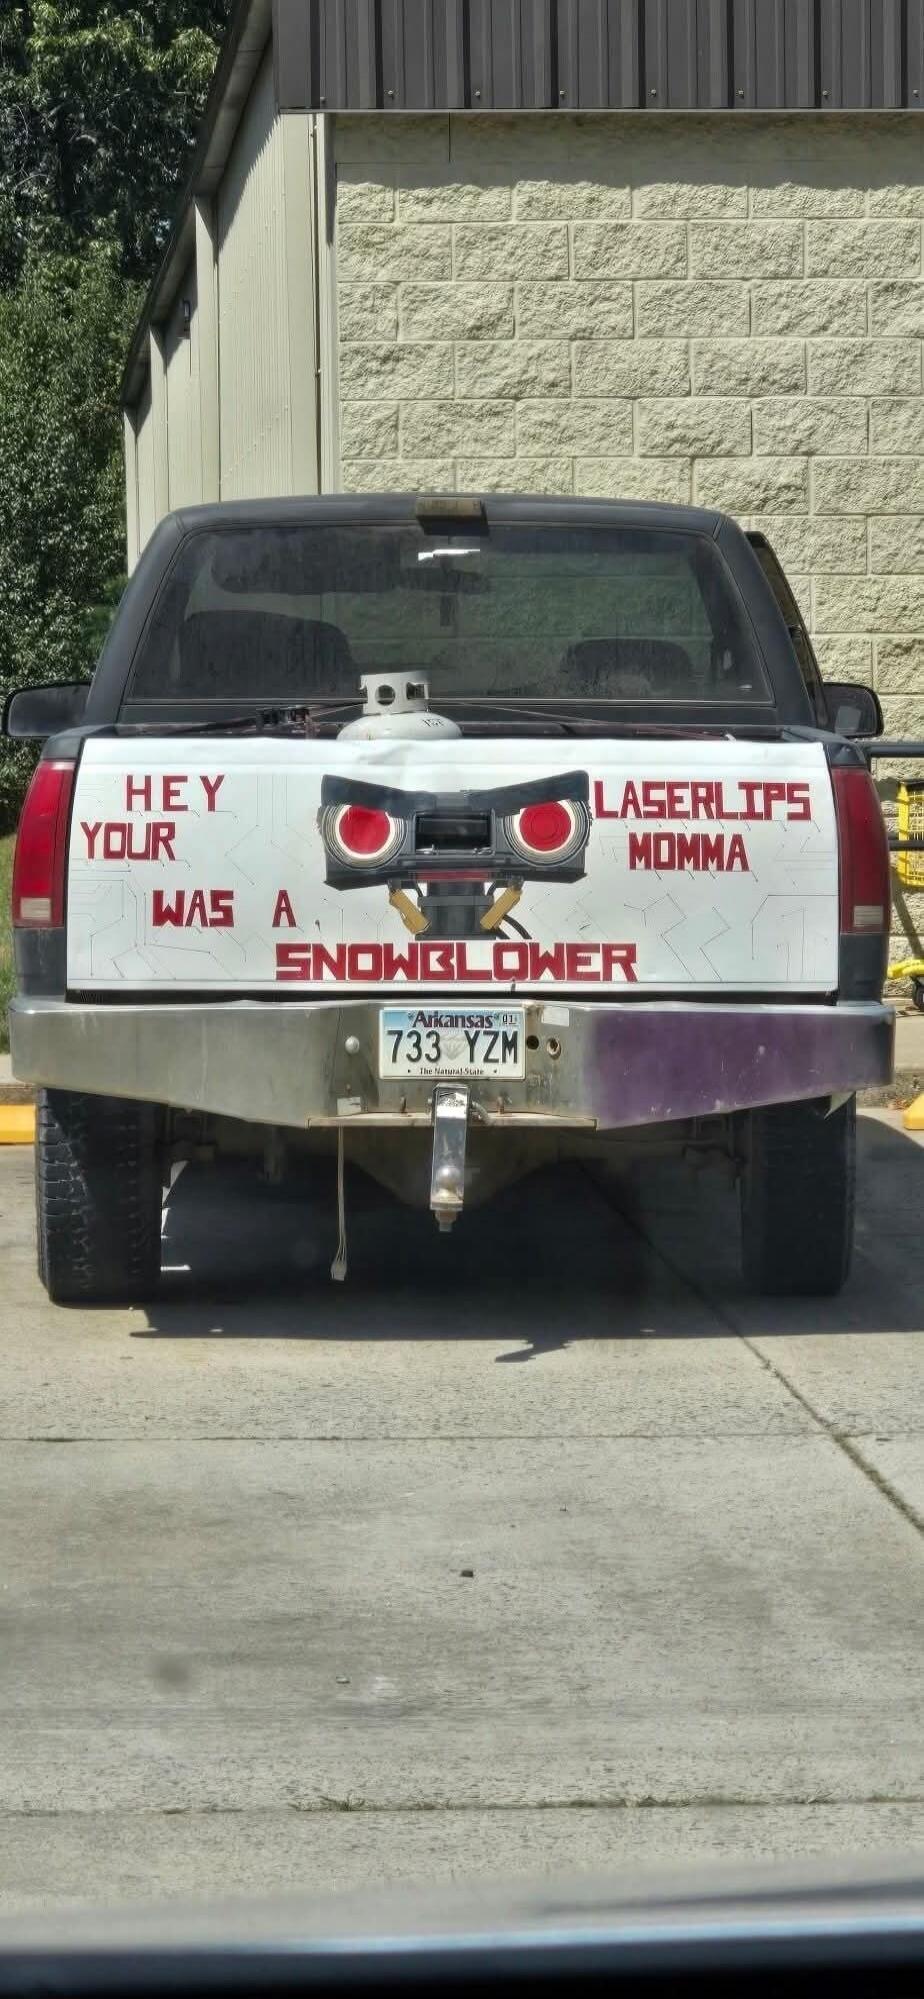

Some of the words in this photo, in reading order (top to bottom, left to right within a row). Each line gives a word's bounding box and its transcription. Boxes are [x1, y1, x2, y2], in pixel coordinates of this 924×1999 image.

[126, 774, 225, 812] HEY
[593, 780, 812, 821] LASERLIPS
[80, 821, 176, 861] YOUR
[628, 831, 750, 872] MOMMA
[152, 889, 235, 928] WAS
[271, 889, 297, 928] A
[275, 942, 638, 982] SNOWBLOWER
[412, 1010, 494, 1029] Arkansas
[387, 1029, 441, 1064] 733
[463, 1030, 519, 1064] YZM
[420, 1067, 433, 1075] The
[434, 1067, 463, 1075] Natural
[464, 1067, 484, 1075] State
